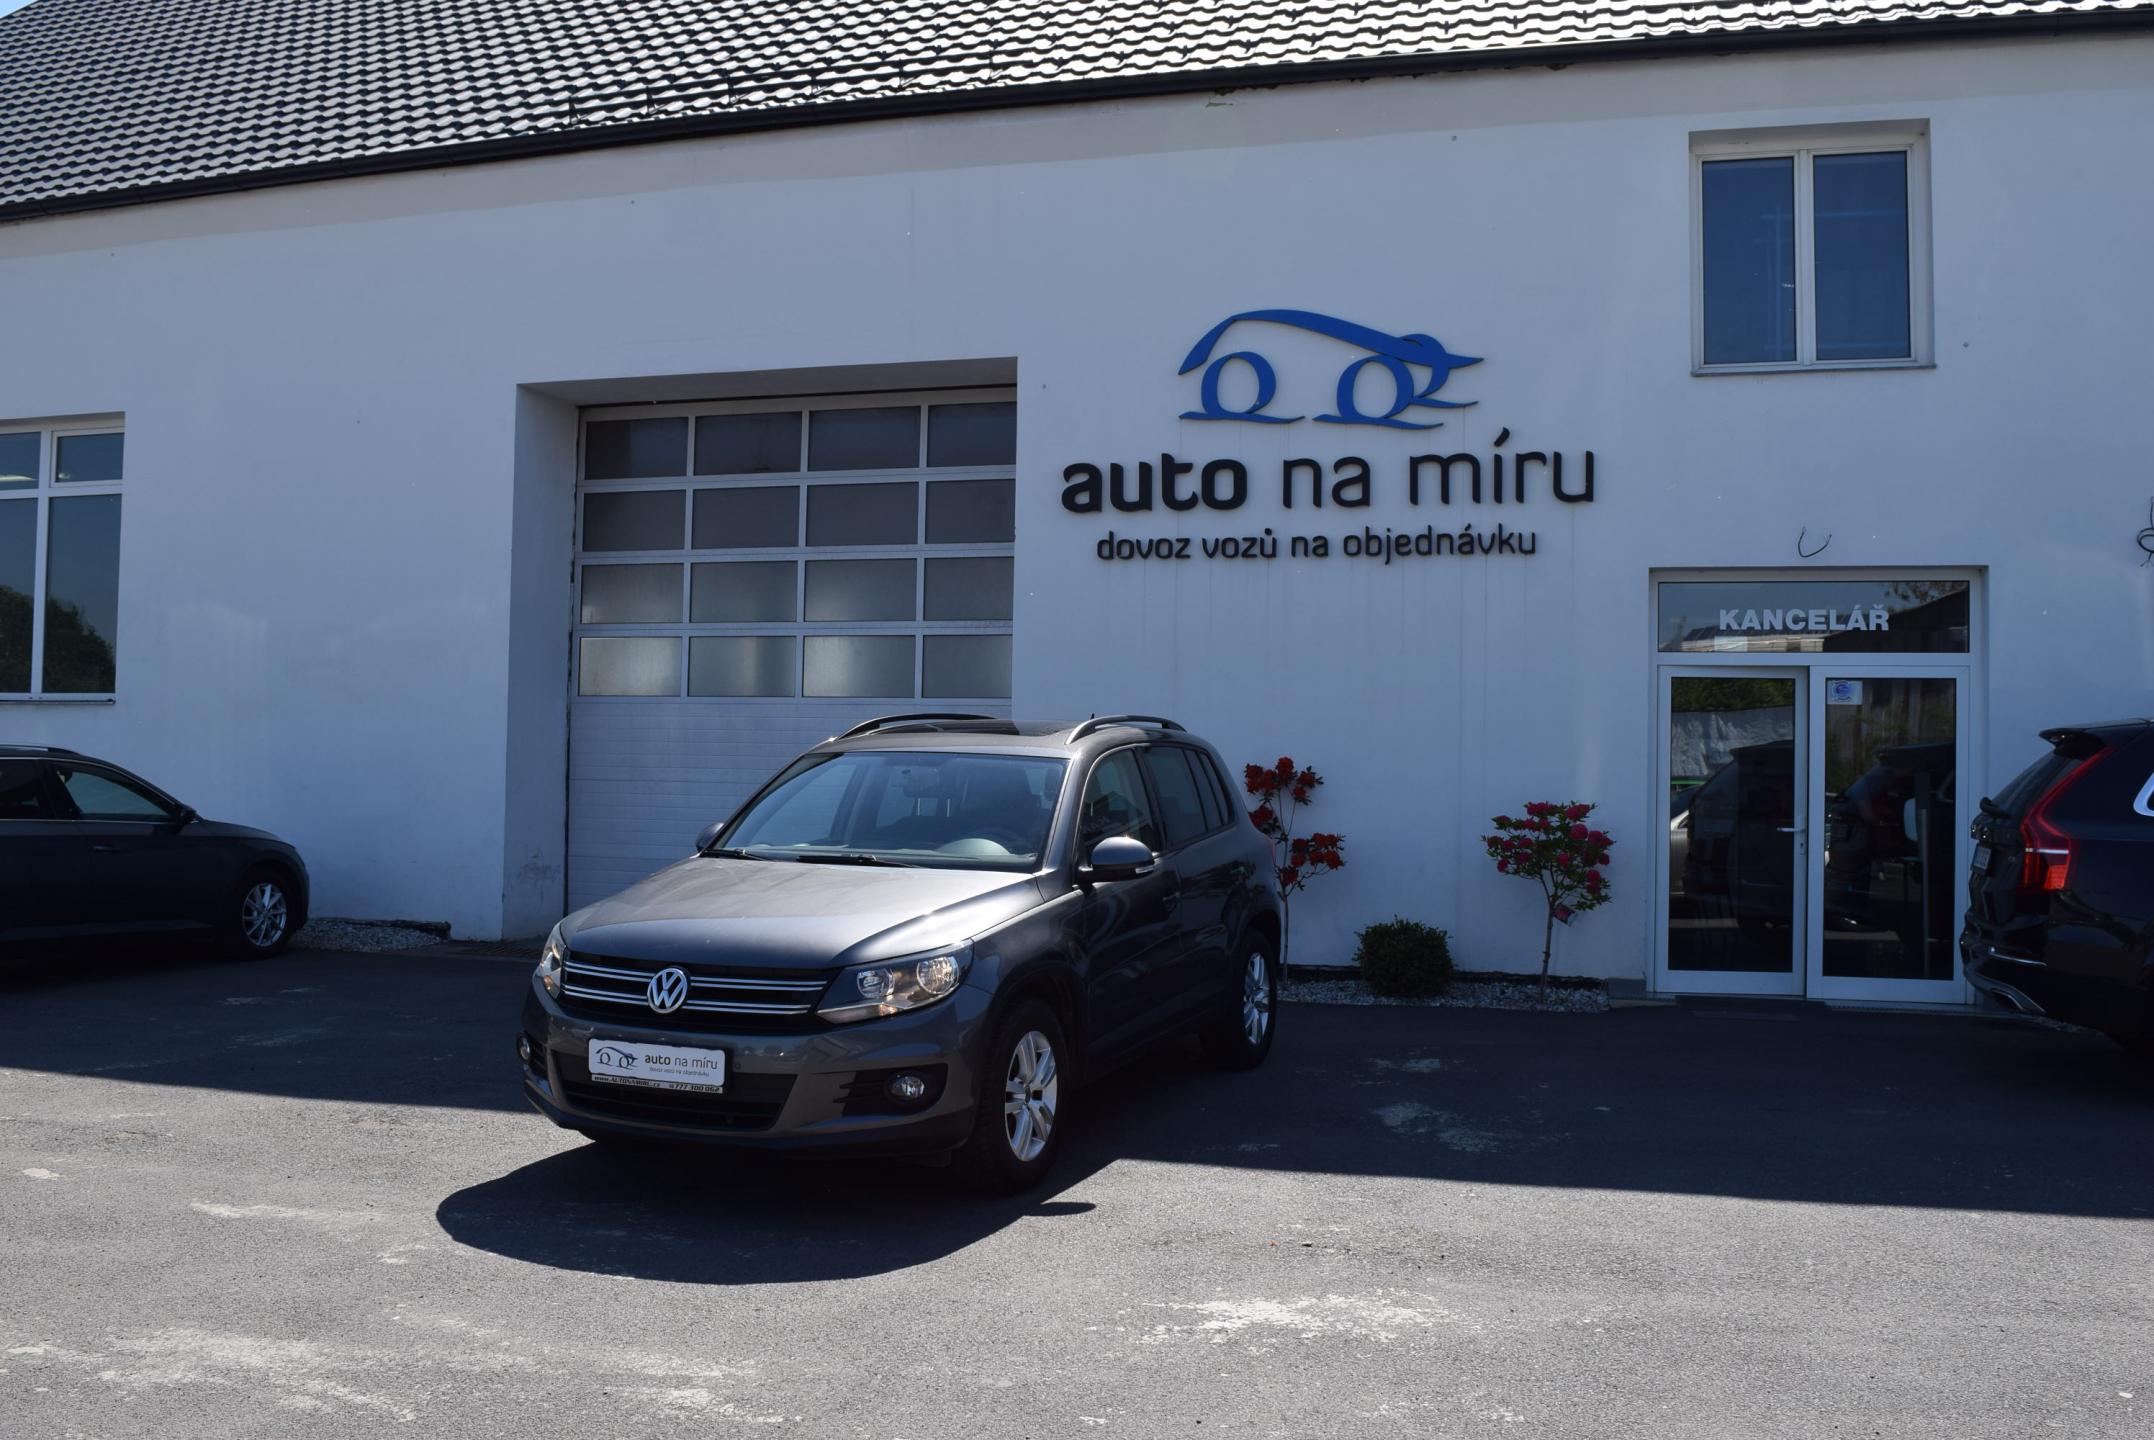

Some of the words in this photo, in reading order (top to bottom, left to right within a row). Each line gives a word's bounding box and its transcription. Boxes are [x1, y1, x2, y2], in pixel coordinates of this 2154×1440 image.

[1061, 453, 1247, 513] auto
[1282, 457, 1371, 509] na
[1409, 427, 1595, 506] míru
[1096, 530, 1191, 561] dovoz
[1201, 527, 1278, 560] vozů
[1290, 535, 1329, 558] na
[1342, 523, 1537, 566] objednávku
[1719, 604, 1890, 631] KANCELÁŘ
[644, 1054, 671, 1066] auto
[674, 1057, 688, 1068] na
[691, 1056, 718, 1070] míru
